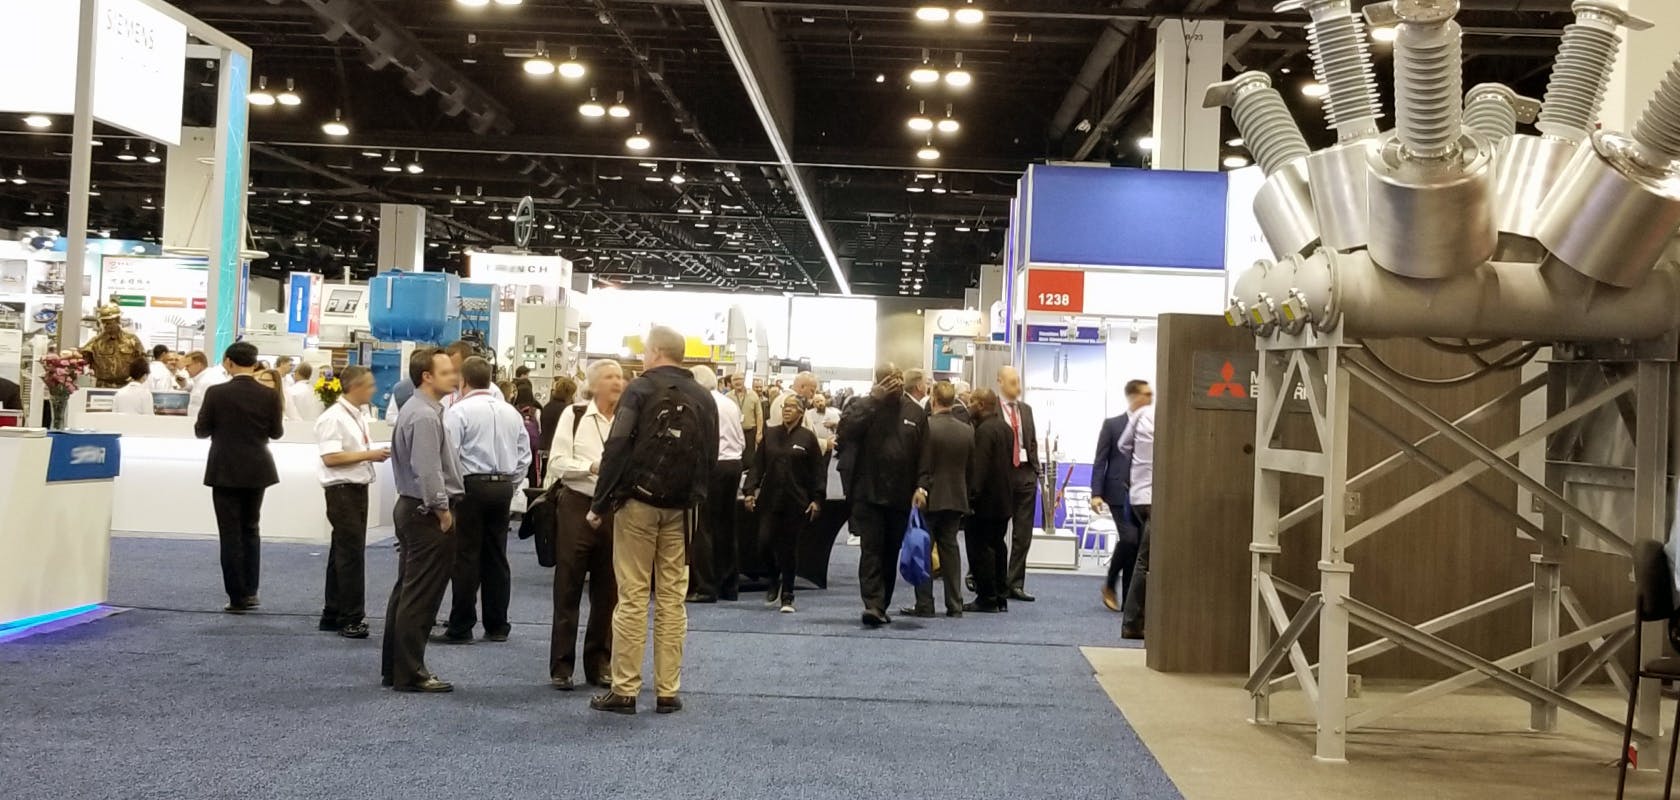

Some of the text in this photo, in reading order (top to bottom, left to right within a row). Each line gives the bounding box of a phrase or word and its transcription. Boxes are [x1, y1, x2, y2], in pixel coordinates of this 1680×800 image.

[106, 8, 155, 50] SIEMENS
[486, 264, 548, 273] NCH
[1038, 293, 1070, 306] 1238
